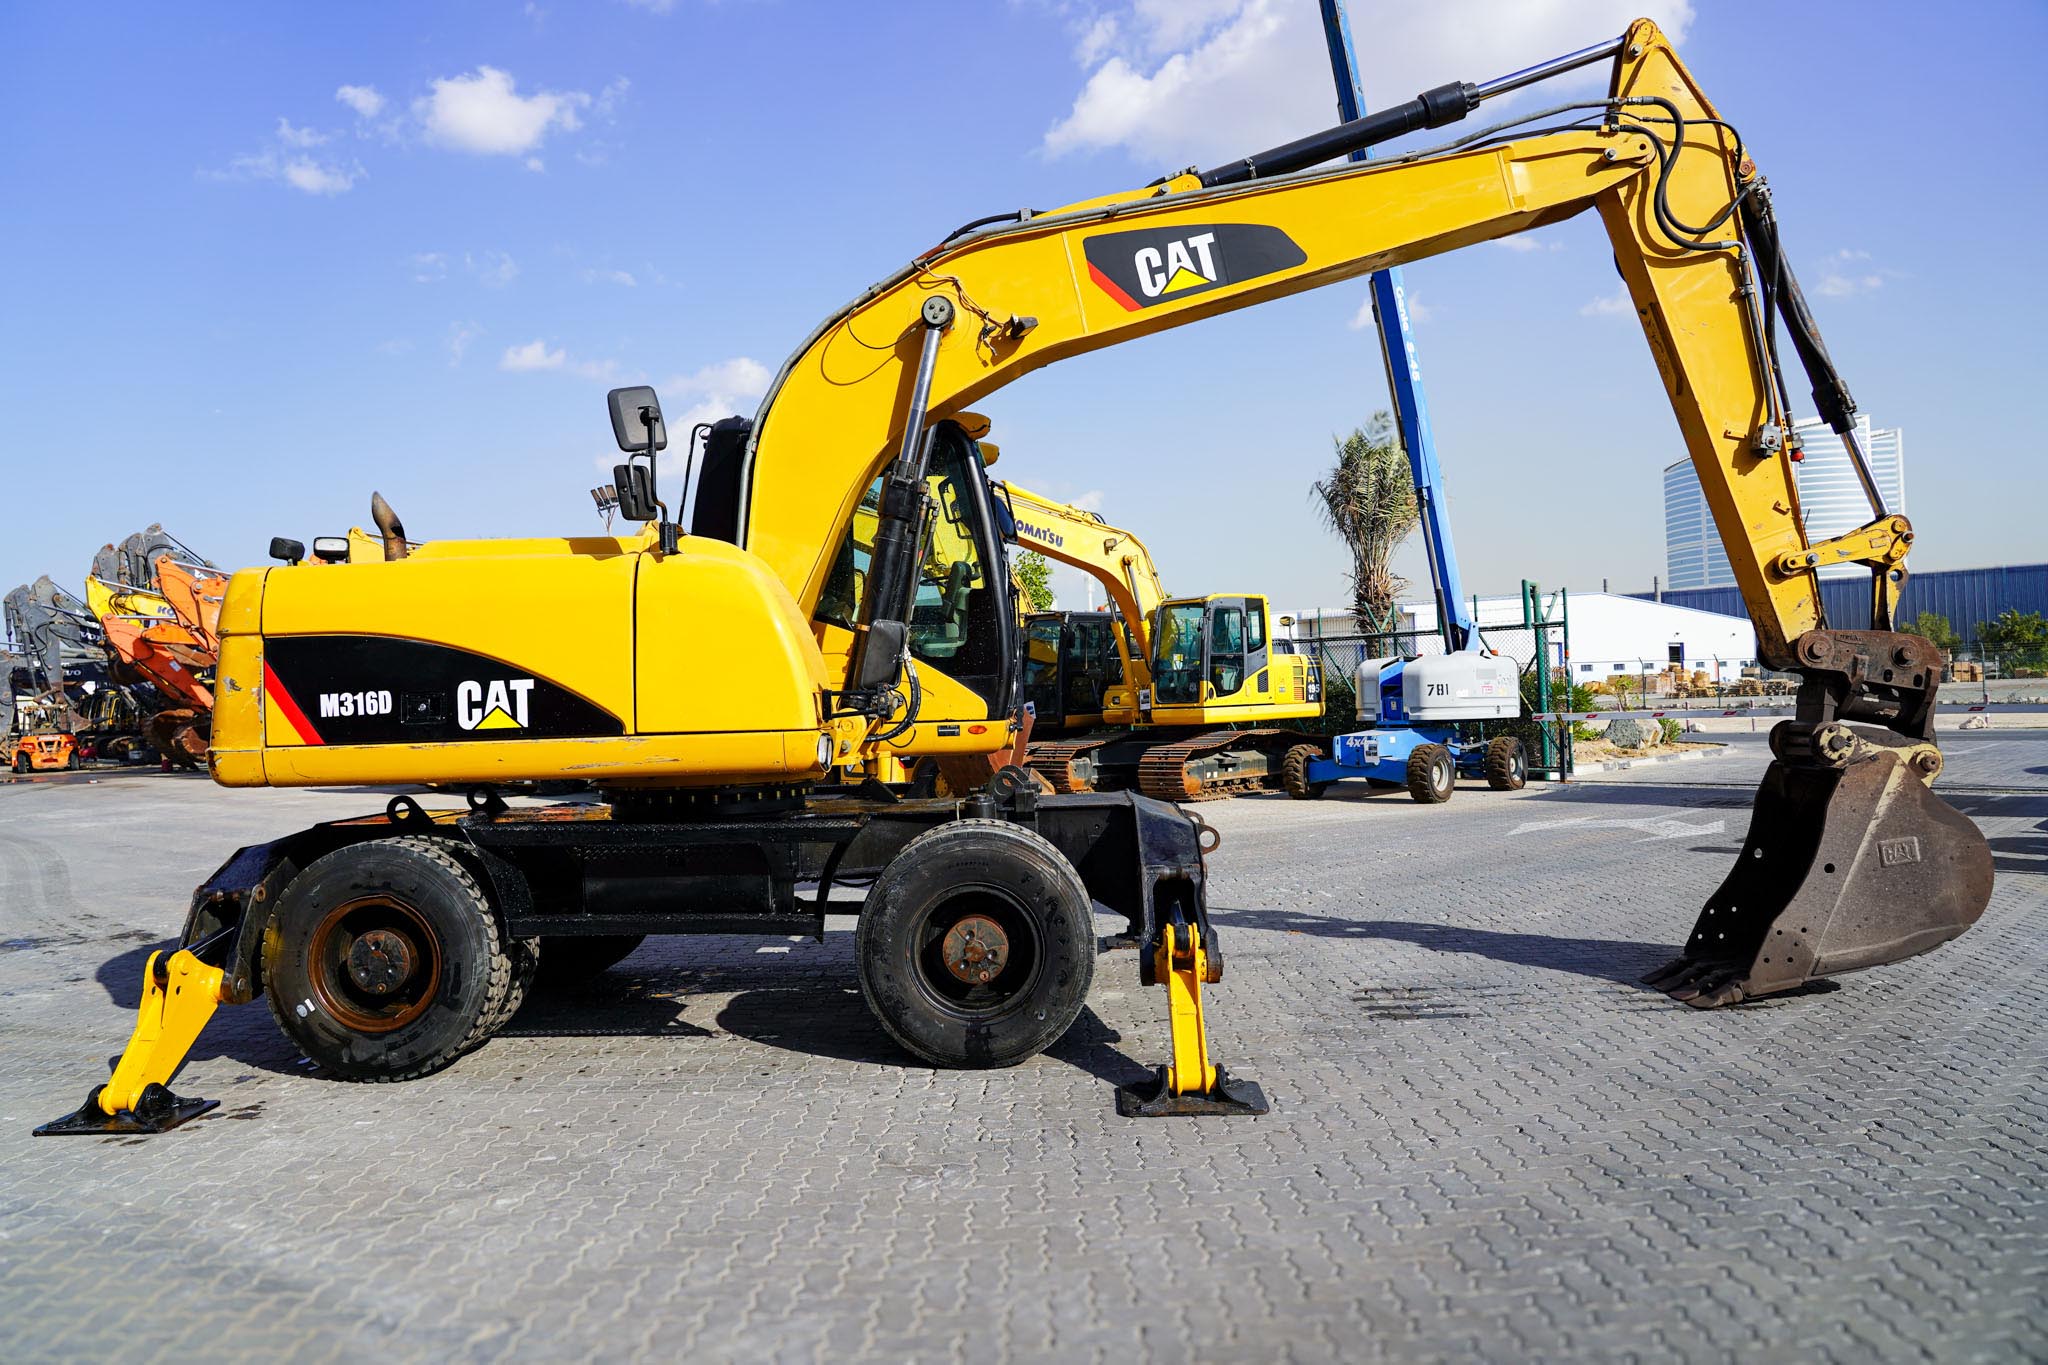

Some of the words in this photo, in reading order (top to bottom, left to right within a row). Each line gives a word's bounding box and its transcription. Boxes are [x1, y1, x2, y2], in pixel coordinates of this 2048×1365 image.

[1134, 232, 1218, 298] CAT
[1015, 519, 1064, 548] OMATSU
[320, 690, 393, 718] M316D
[456, 678, 535, 731] CAT
[1427, 683, 1449, 697] 781
[1882, 842, 1916, 865] CAT
